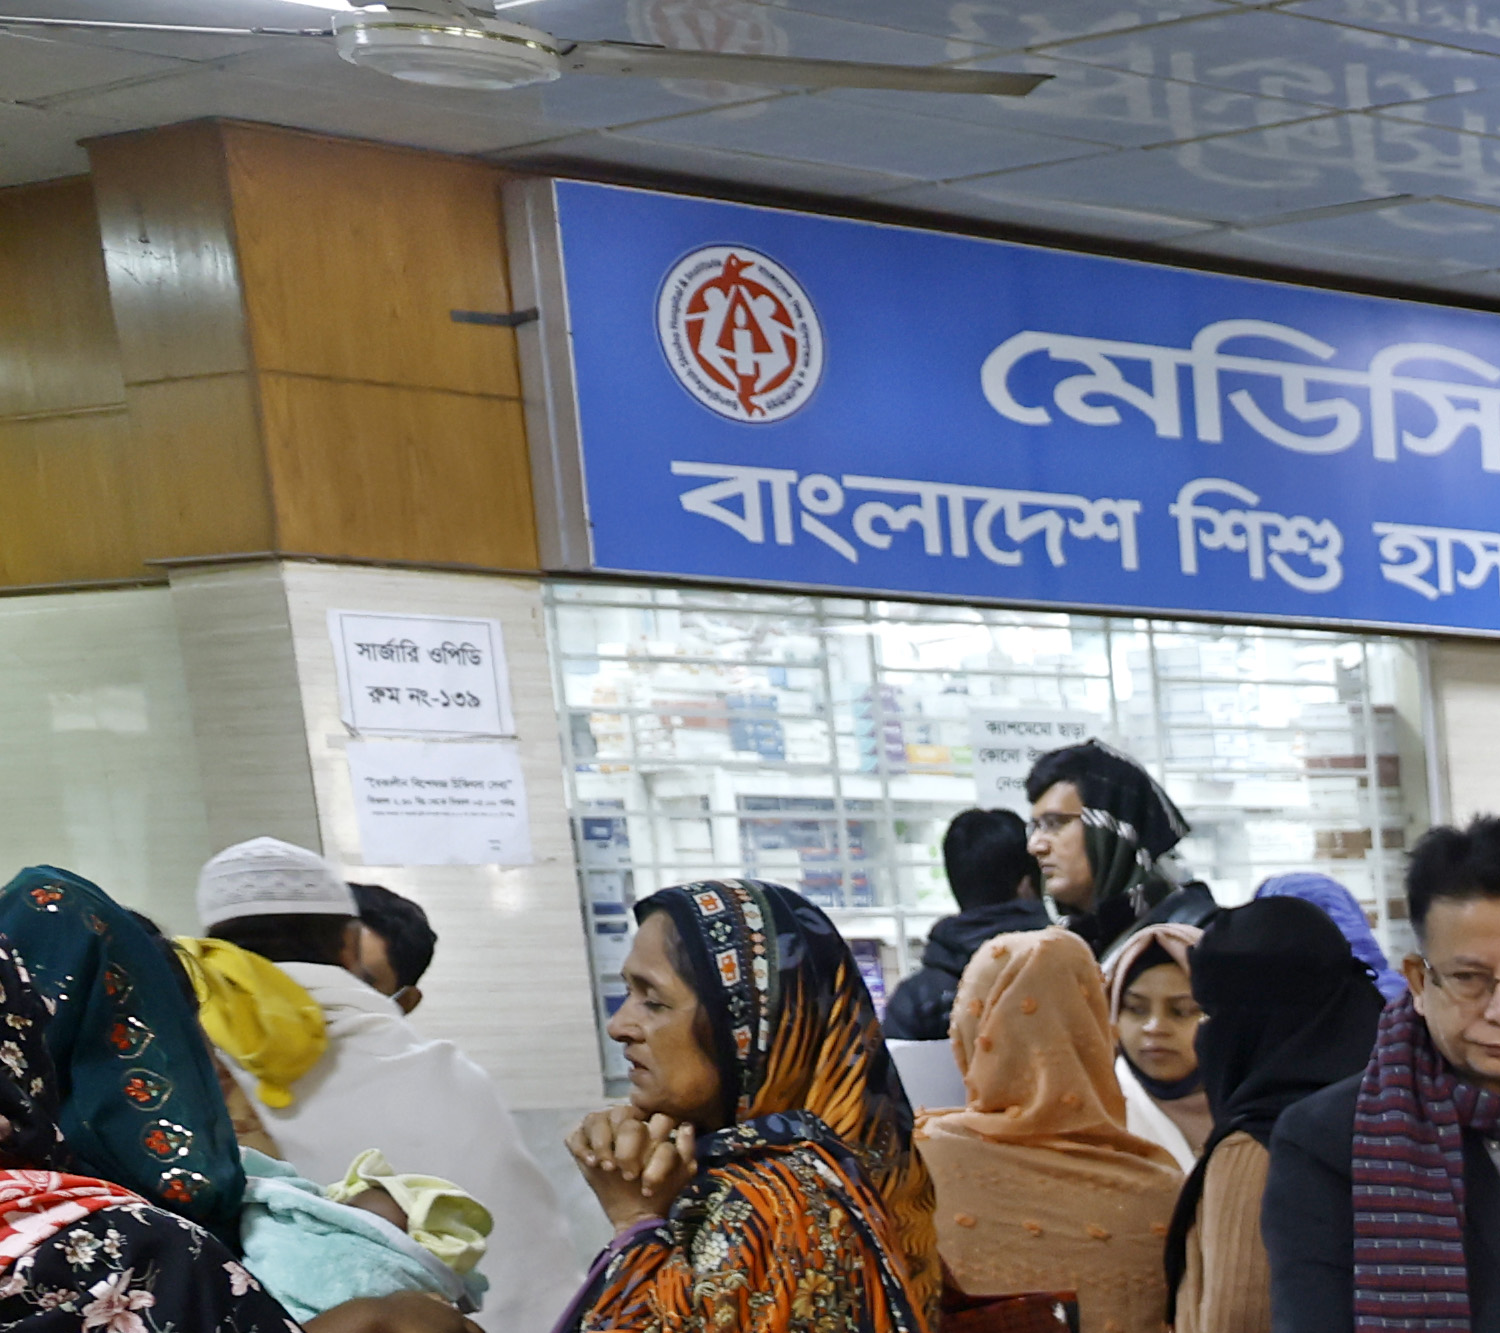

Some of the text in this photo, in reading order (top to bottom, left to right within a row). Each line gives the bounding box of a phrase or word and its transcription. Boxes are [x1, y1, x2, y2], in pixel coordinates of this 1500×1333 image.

[670, 461, 1142, 571] বাংলাদেশ
[1169, 477, 1345, 594] শিশু
[354, 638, 482, 665] সার্জারি ওপিডি
[365, 685, 401, 704] রুম
[985, 720, 1086, 739] ক্যাশমেমো ছাড়া
[979, 749, 1020, 763] কোনো
